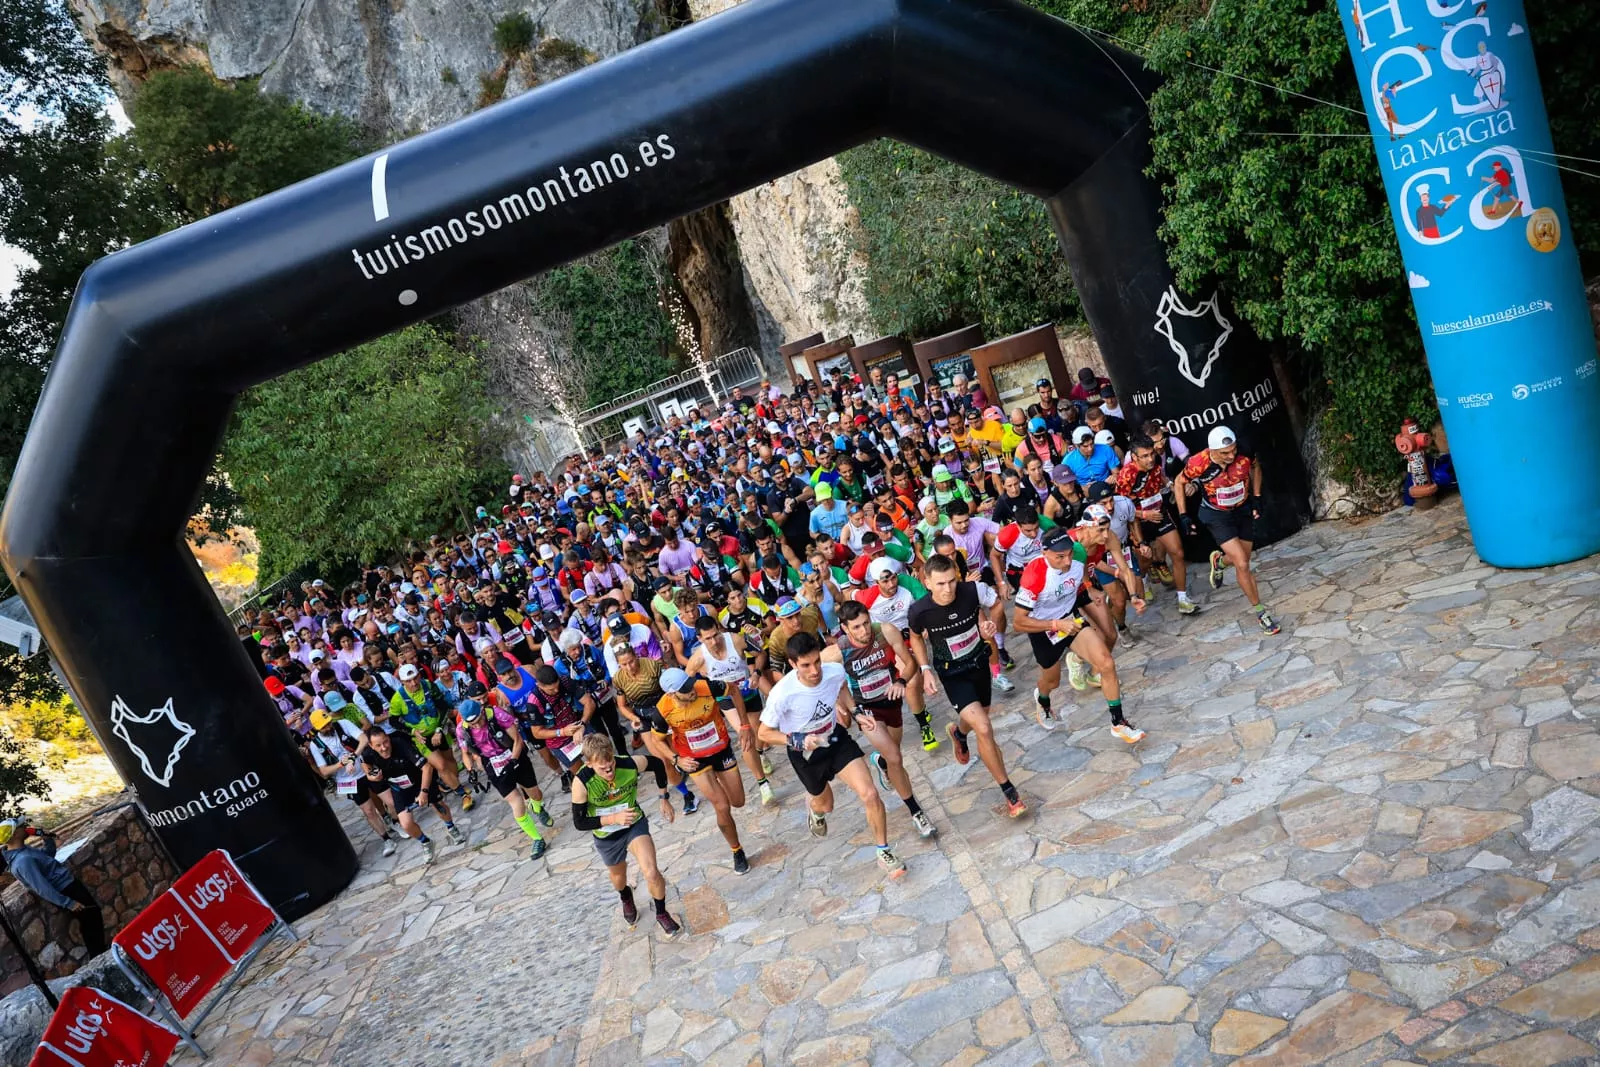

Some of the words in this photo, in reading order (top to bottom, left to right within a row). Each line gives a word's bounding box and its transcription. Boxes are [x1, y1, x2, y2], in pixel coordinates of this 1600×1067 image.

[351, 133, 677, 281] turismosomontano.es
[1431, 299, 1544, 334] huescalamagia.es
[1132, 386, 1161, 407] vive!
[1251, 397, 1279, 424] guara
[148, 771, 261, 828] omontano
[225, 788, 270, 818] guara
[134, 917, 178, 961] utgs
[65, 1008, 109, 1054] utgs
